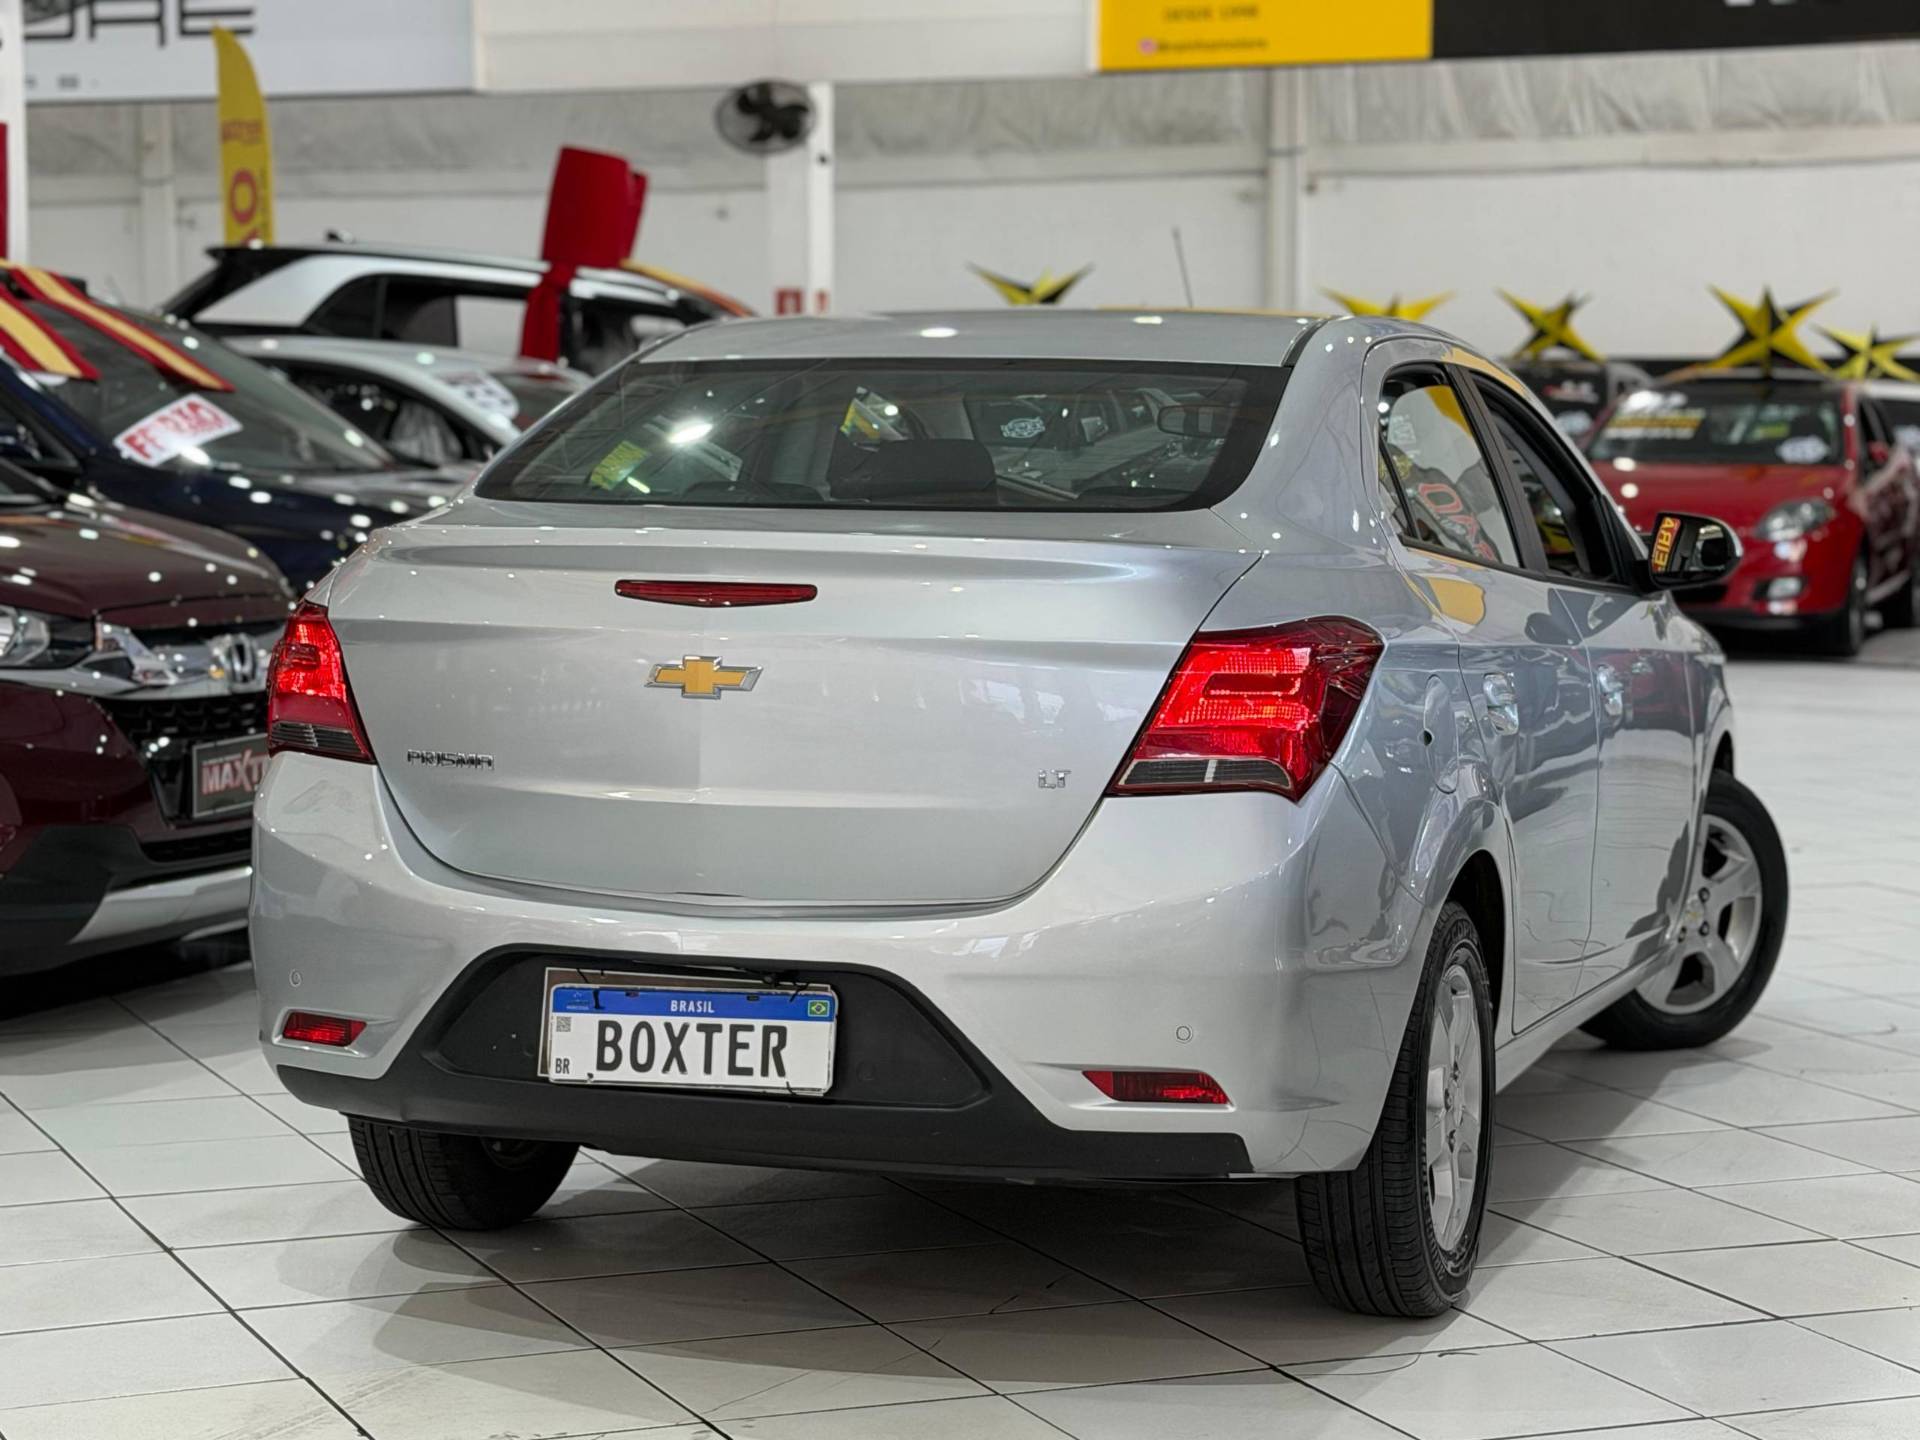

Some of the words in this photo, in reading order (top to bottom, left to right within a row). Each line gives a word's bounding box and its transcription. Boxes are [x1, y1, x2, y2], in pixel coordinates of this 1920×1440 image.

[407, 749, 494, 769] PRISMA
[1038, 769, 1071, 789] LT
[670, 999, 715, 1013] BRASIL
[596, 1020, 788, 1077] BOXTER
[555, 1057, 570, 1075] BR
